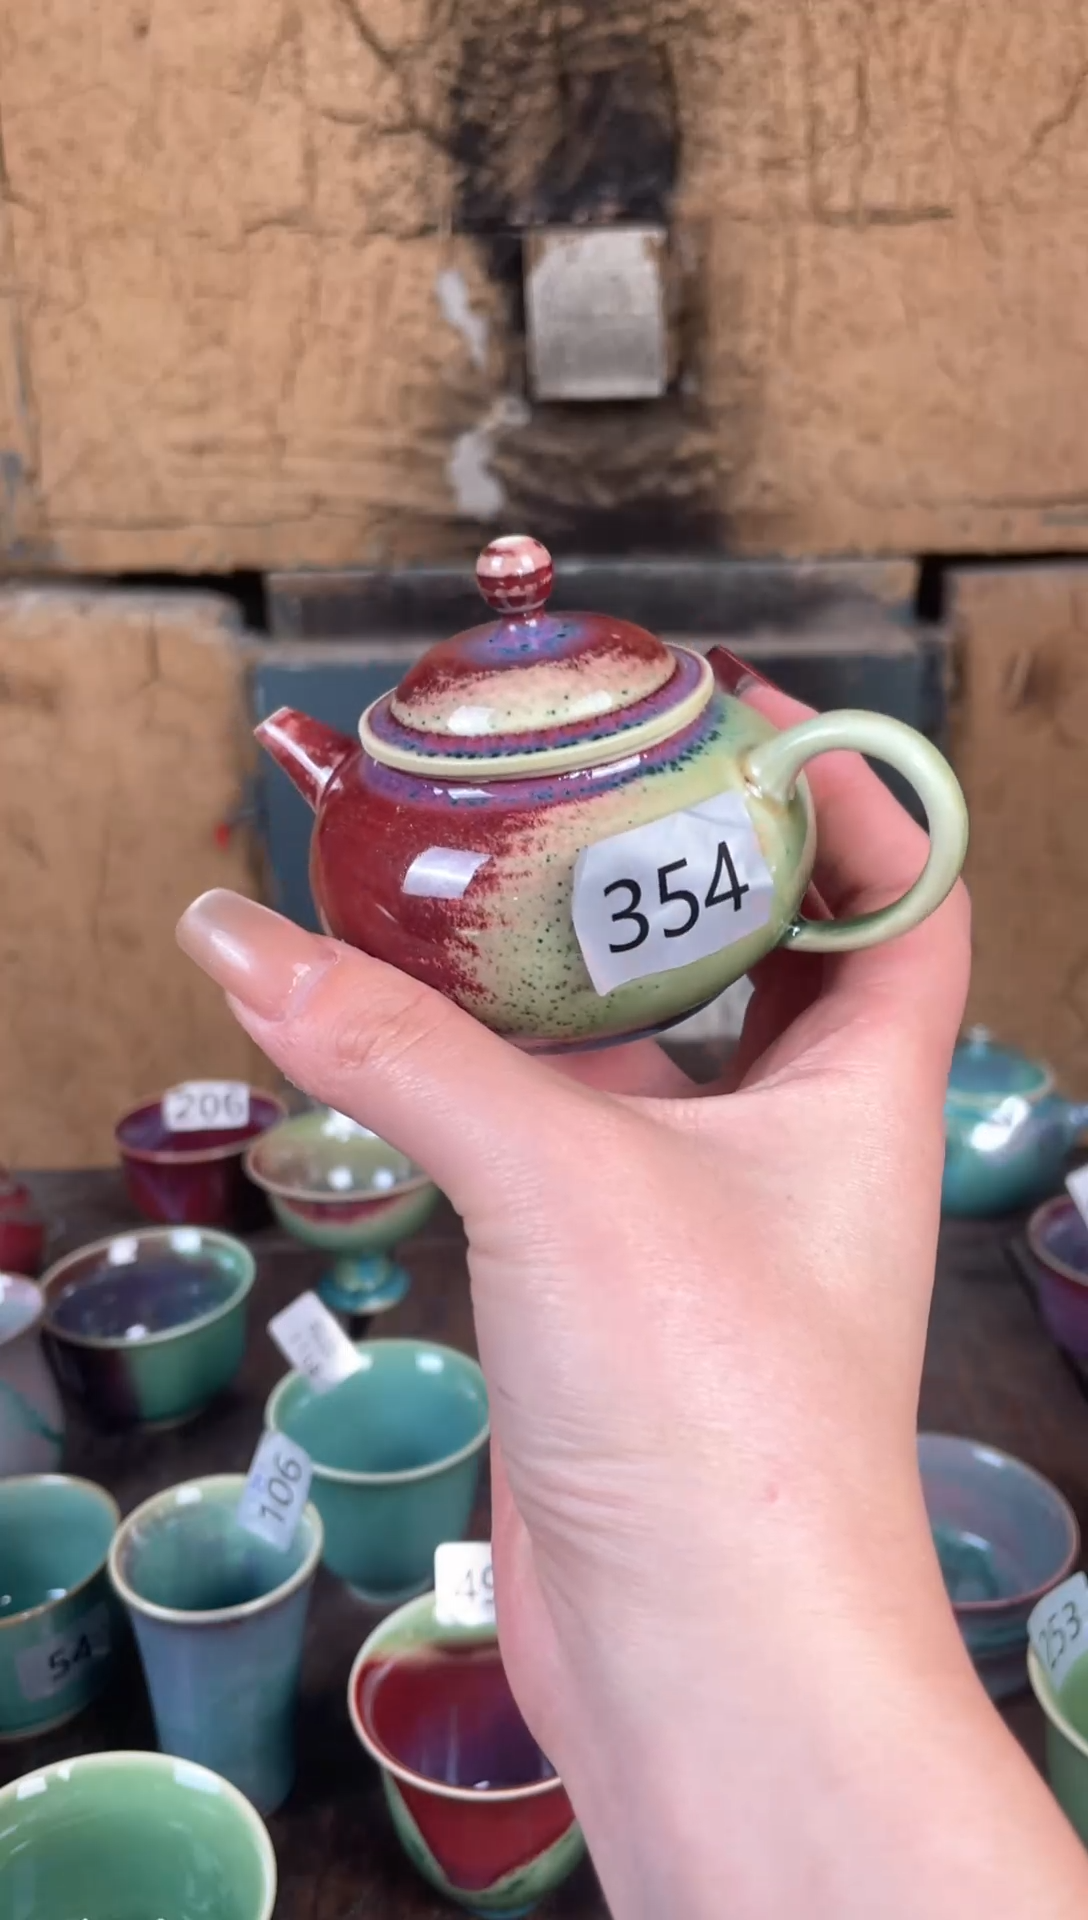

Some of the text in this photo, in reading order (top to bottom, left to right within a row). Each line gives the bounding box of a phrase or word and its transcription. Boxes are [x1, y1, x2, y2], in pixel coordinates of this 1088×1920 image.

[603, 840, 750, 953] 354
[175, 1092, 245, 1124] 206
[260, 1451, 303, 1524] 106
[48, 1634, 93, 1682] 54
[1039, 1600, 1082, 1671] 253
